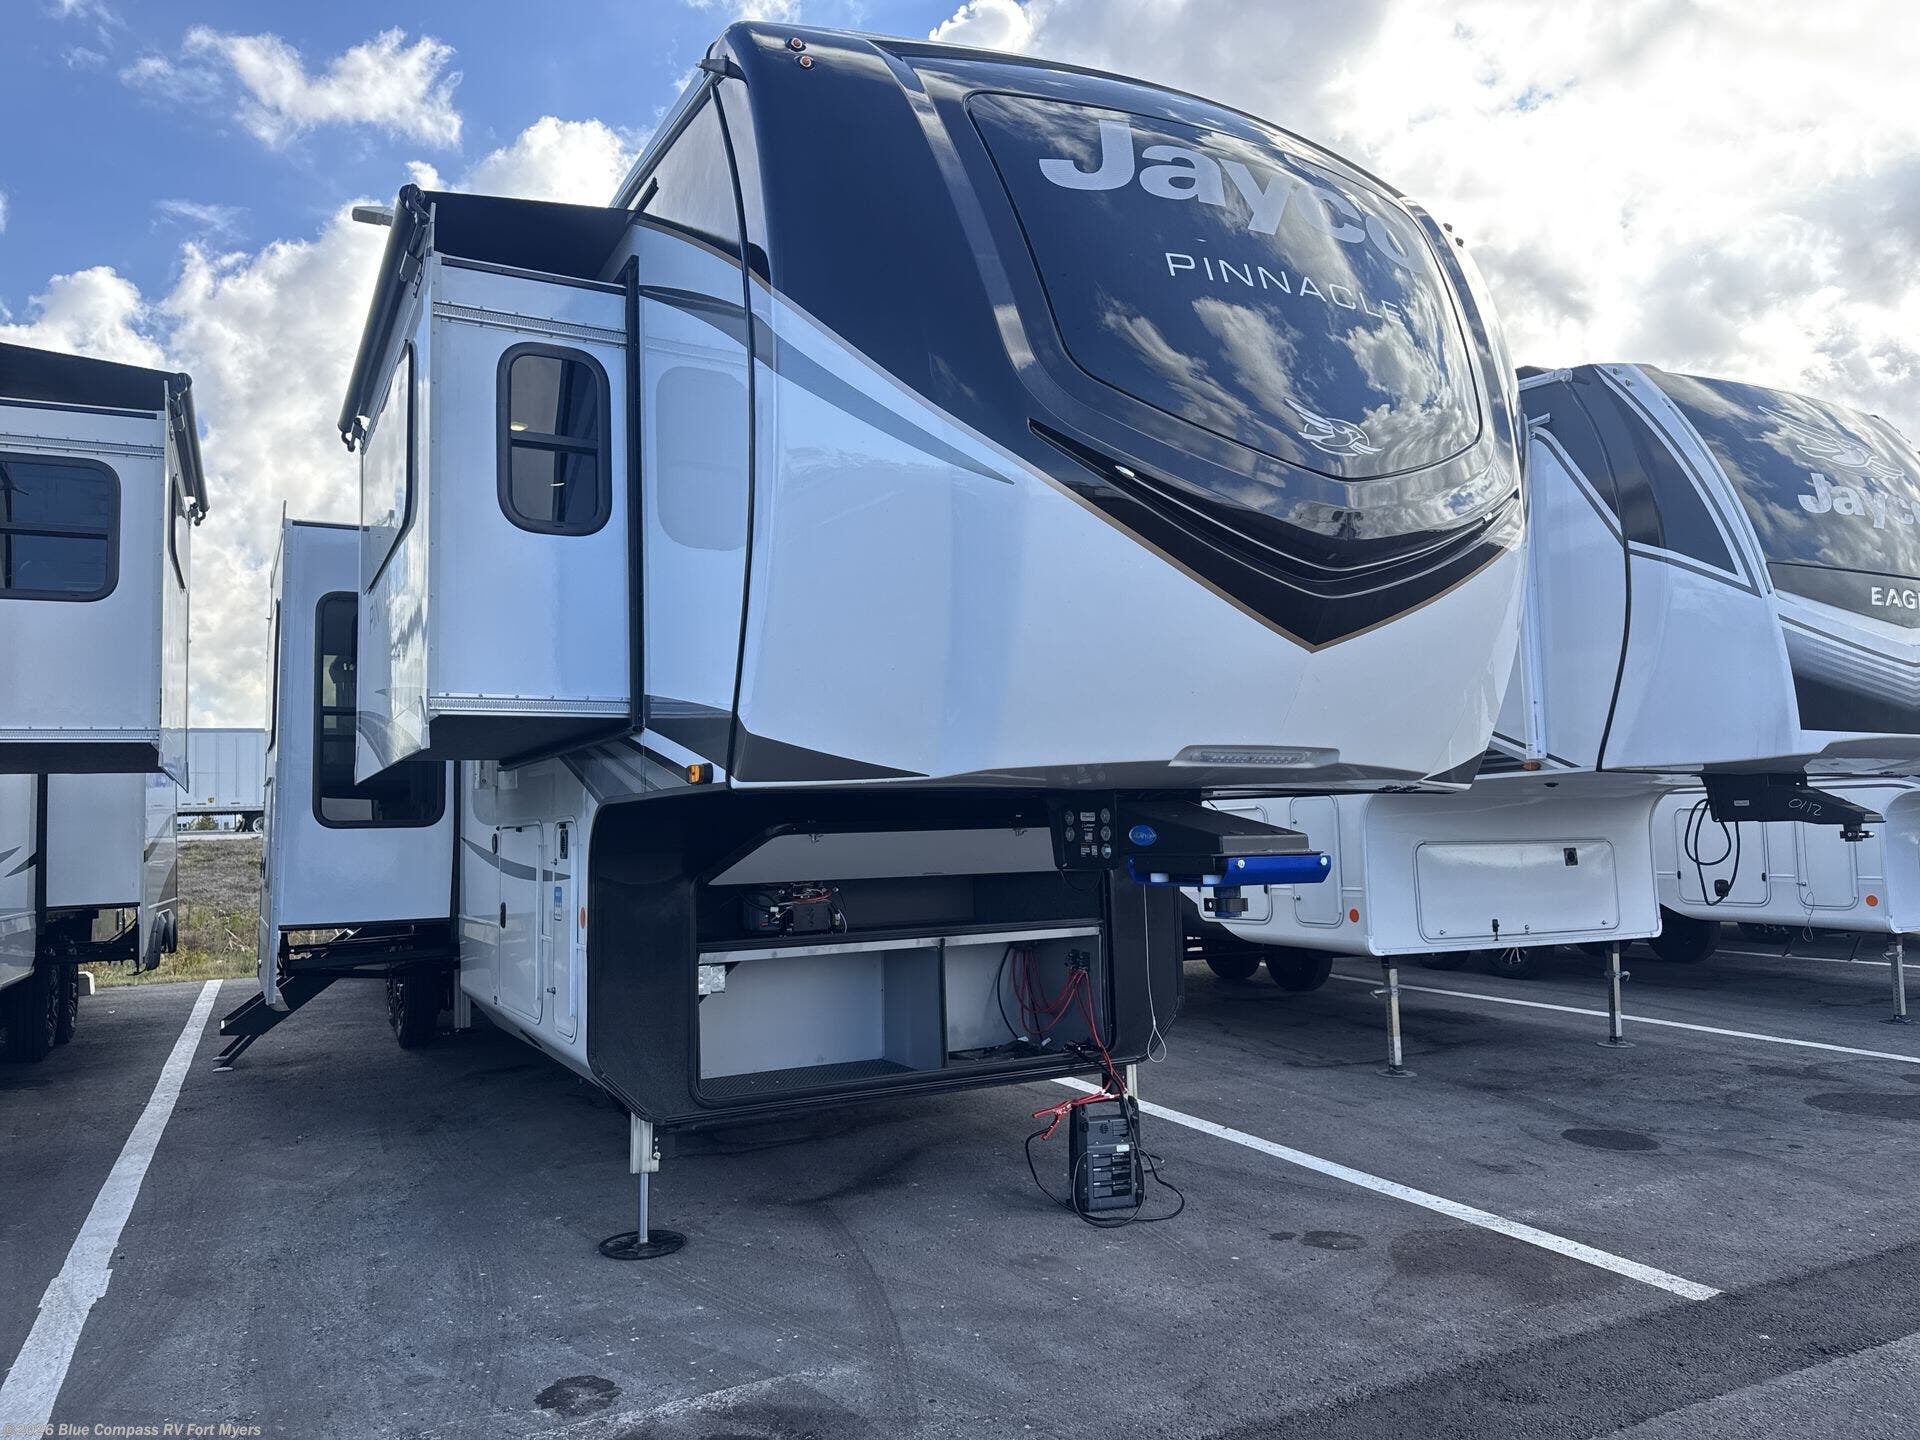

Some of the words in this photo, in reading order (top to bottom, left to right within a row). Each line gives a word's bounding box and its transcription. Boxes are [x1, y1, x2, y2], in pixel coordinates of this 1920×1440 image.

[1039, 119, 1425, 274] Jayco
[1165, 253, 1405, 327] PINNACLE
[1871, 586, 1920, 610] EAG
